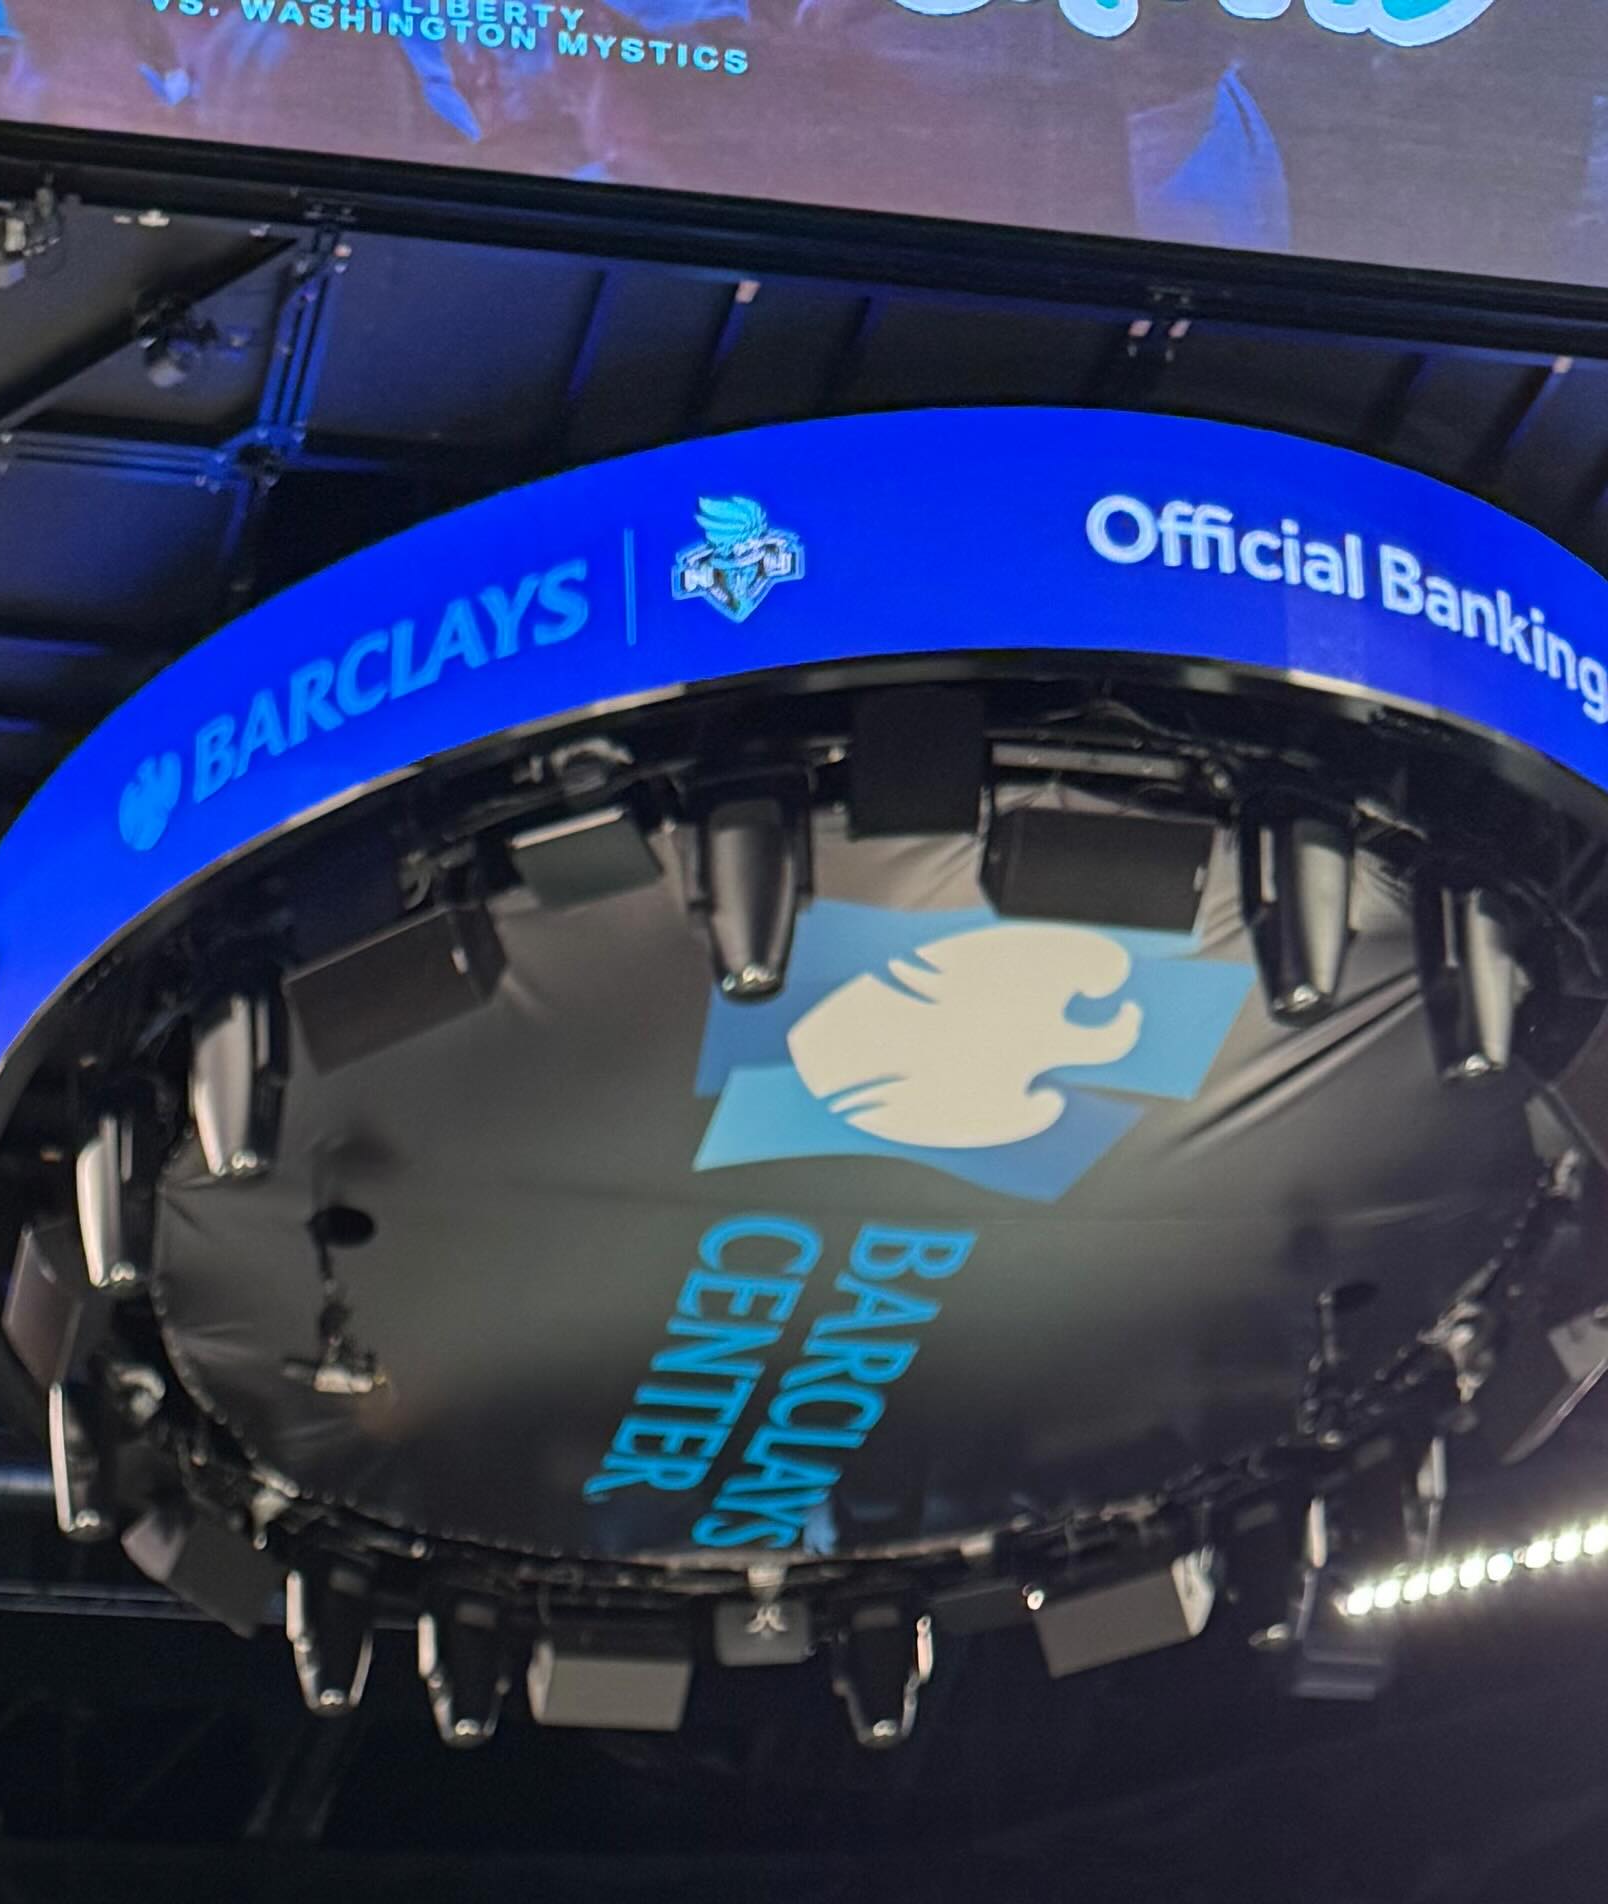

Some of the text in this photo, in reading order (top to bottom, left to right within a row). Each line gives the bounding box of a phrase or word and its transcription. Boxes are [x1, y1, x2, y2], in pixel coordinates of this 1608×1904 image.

[242, 0, 536, 50] WASHINGTON
[558, 30, 749, 74] MYSTICS
[403, 0, 584, 32] LIBERTY
[192, 558, 589, 803] BARCLAYS
[1085, 494, 1608, 725] Official Banking
[583, 1213, 824, 1503] CENTER
[691, 1224, 978, 1549] BARCLAYS
